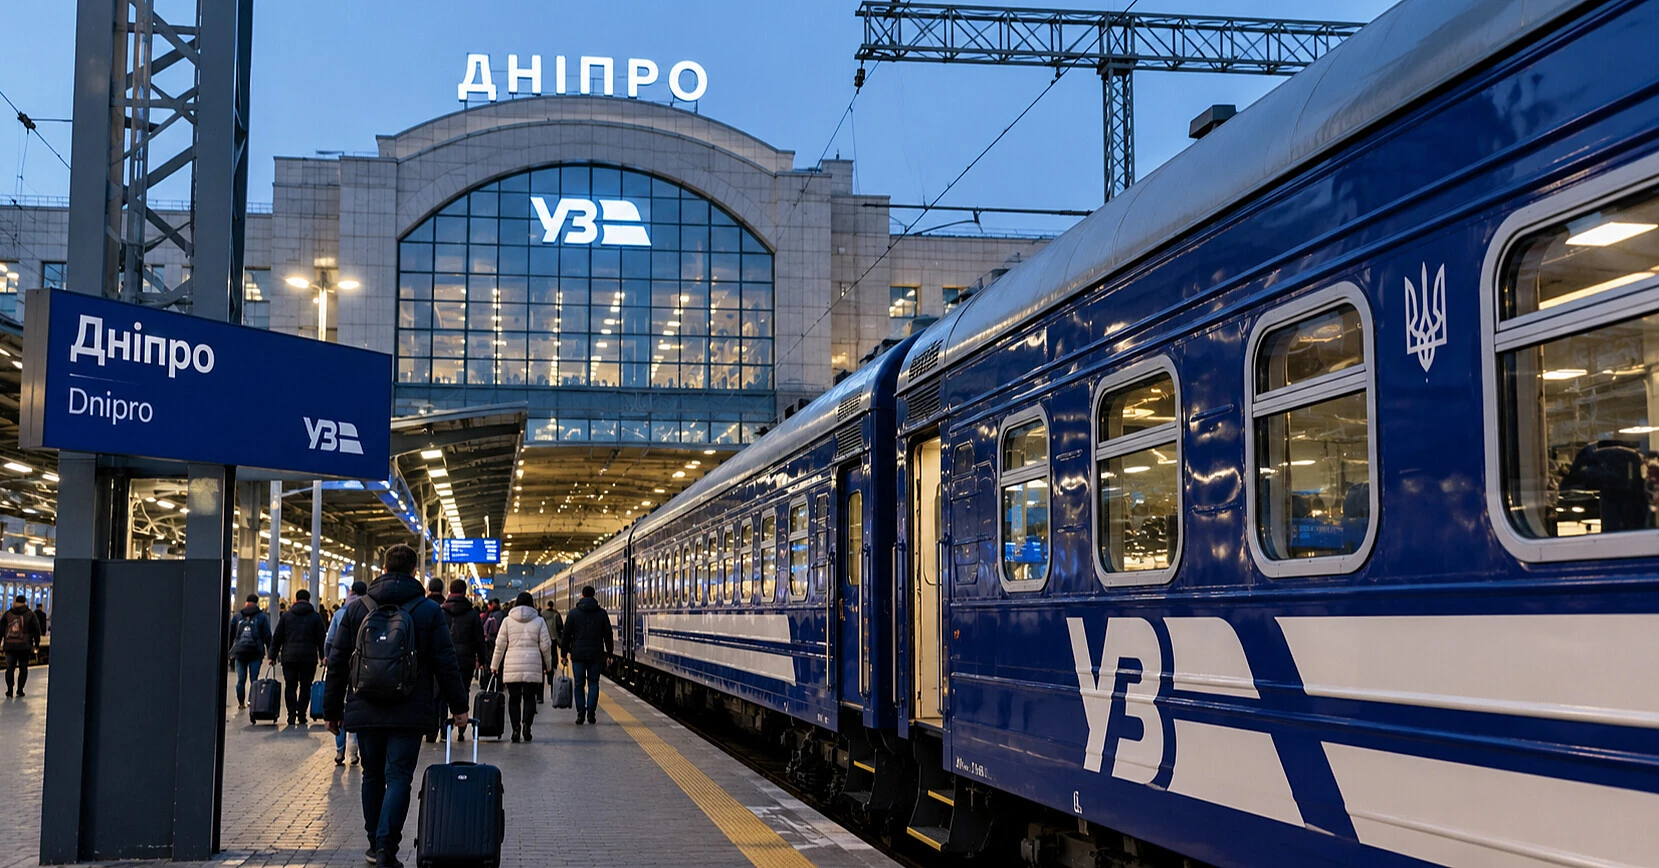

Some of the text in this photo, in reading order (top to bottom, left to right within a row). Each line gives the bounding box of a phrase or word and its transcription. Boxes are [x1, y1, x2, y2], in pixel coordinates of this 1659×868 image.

[457, 54, 708, 101] ДНІПРО
[530, 197, 598, 244] УЗ
[69, 314, 215, 379] Дніпро
[68, 387, 153, 425] Dnipro
[303, 416, 338, 451] УЗ
[1065, 616, 1164, 785] УЗ
